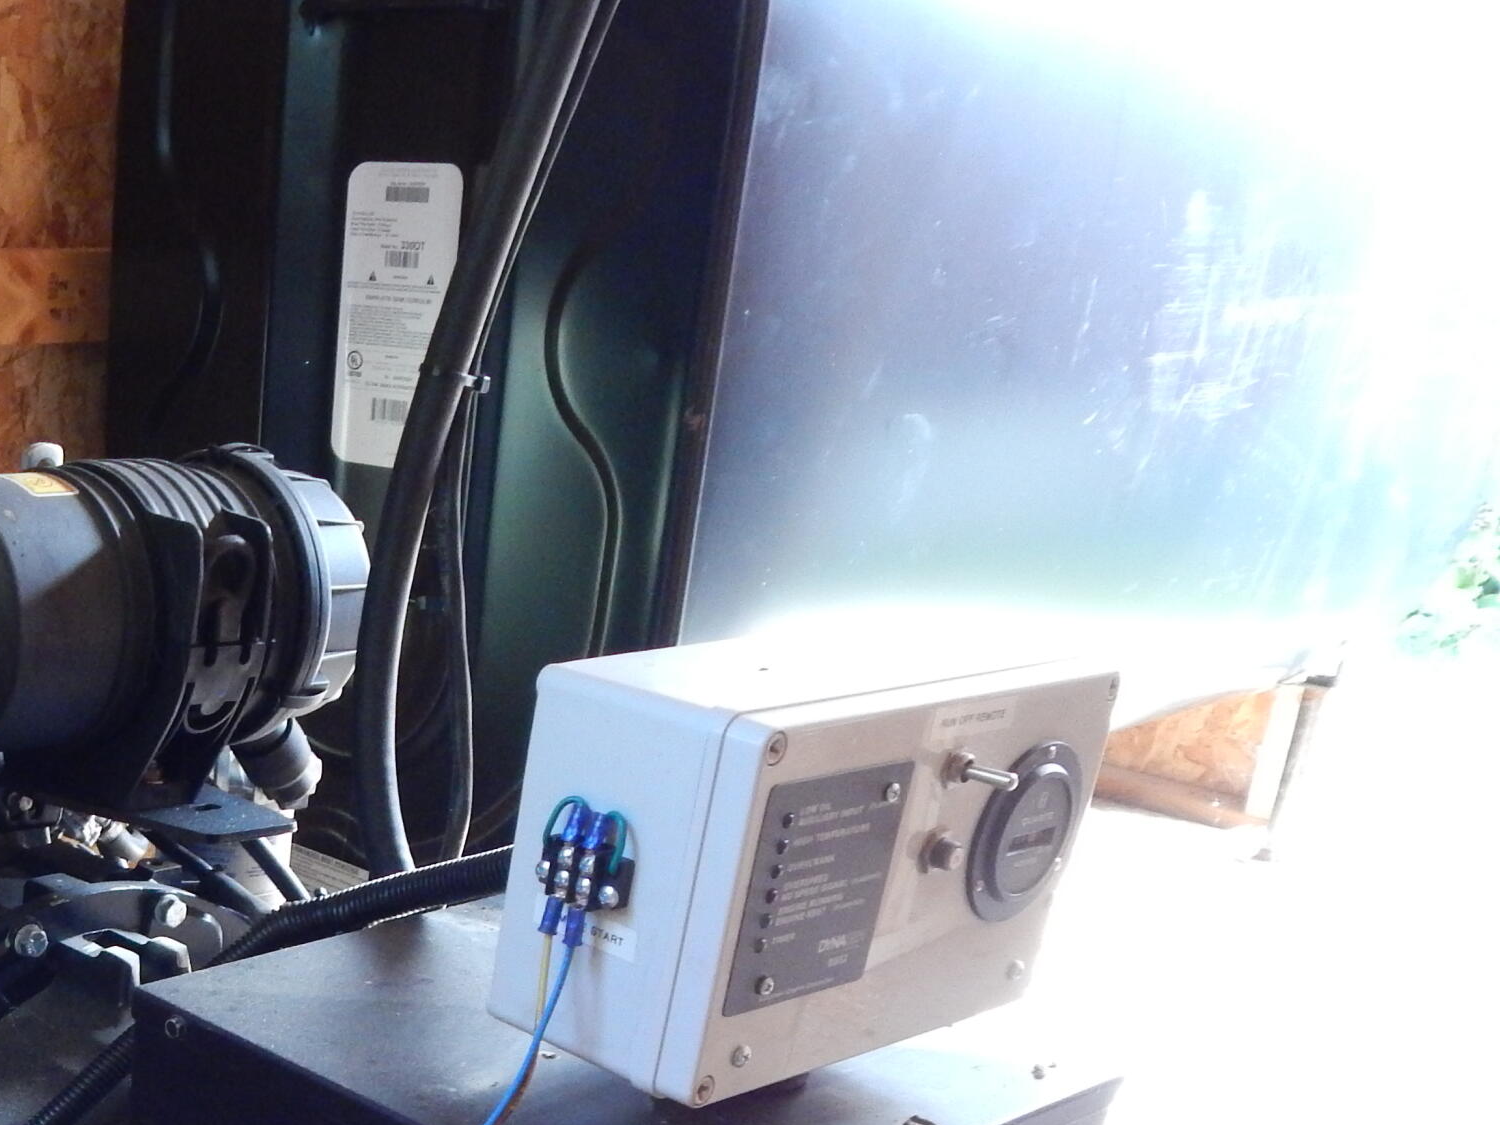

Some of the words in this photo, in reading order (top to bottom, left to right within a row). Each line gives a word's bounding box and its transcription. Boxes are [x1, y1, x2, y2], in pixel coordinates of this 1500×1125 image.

[958, 713, 975, 725] OFF
[976, 709, 1007, 722] REMOTE
[590, 926, 625, 946] START
